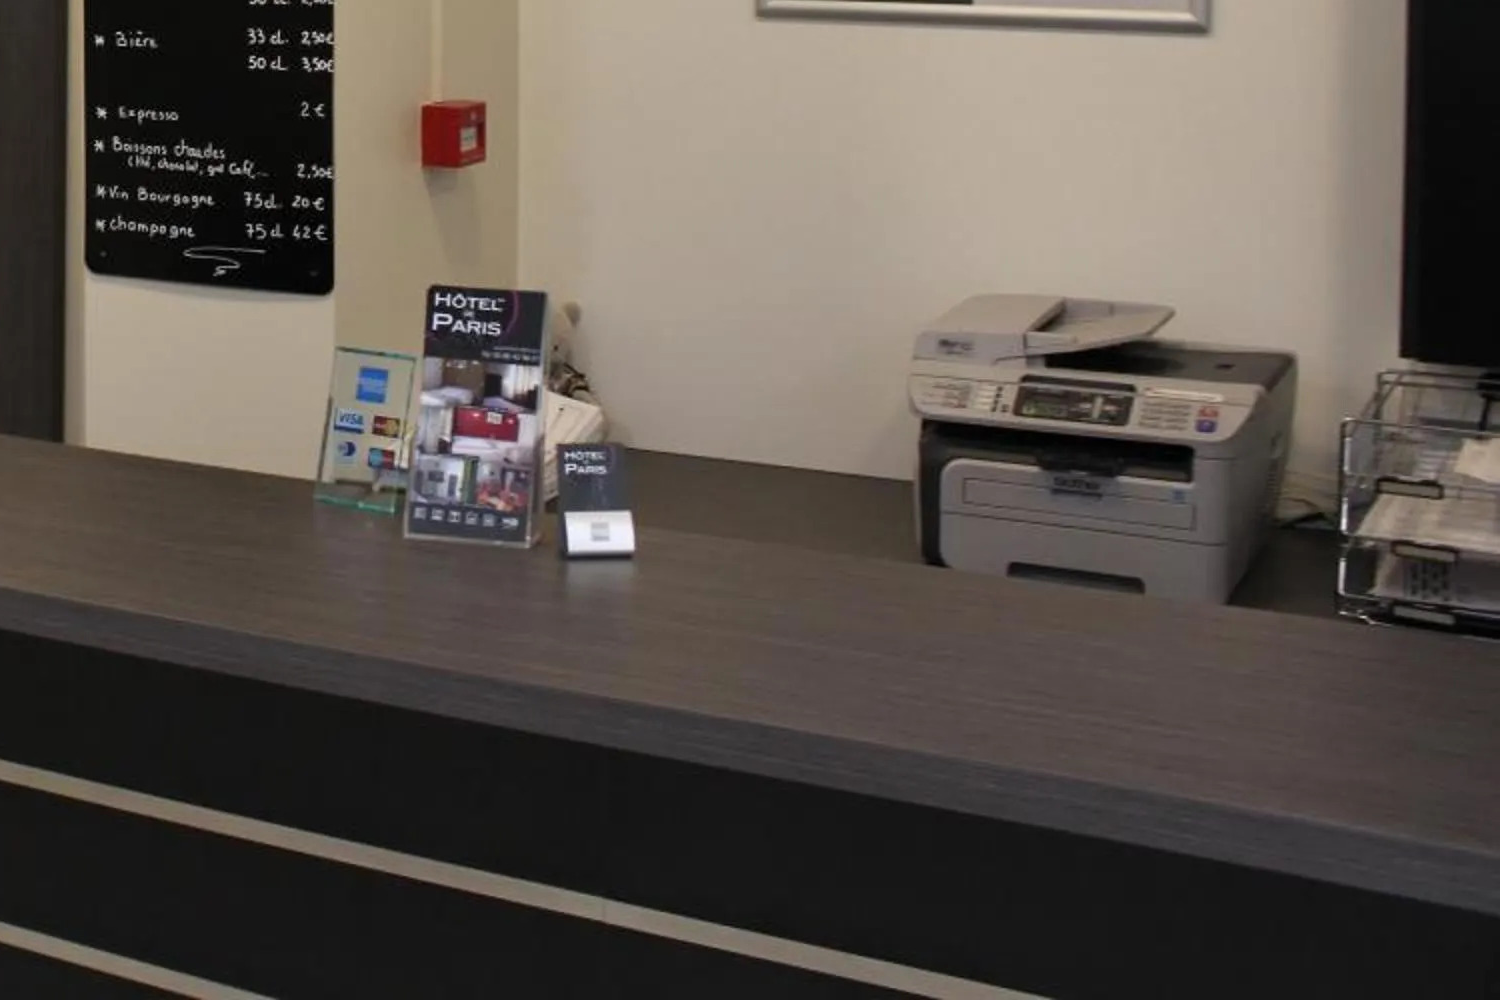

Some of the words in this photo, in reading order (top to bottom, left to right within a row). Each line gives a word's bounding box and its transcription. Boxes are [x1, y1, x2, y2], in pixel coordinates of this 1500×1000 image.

[118, 105, 179, 126] Expresso
[109, 185, 129, 200] Vin
[137, 186, 215, 209] Bourgogne
[434, 292, 504, 313] HÔTEL
[339, 409, 364, 426] VISA
